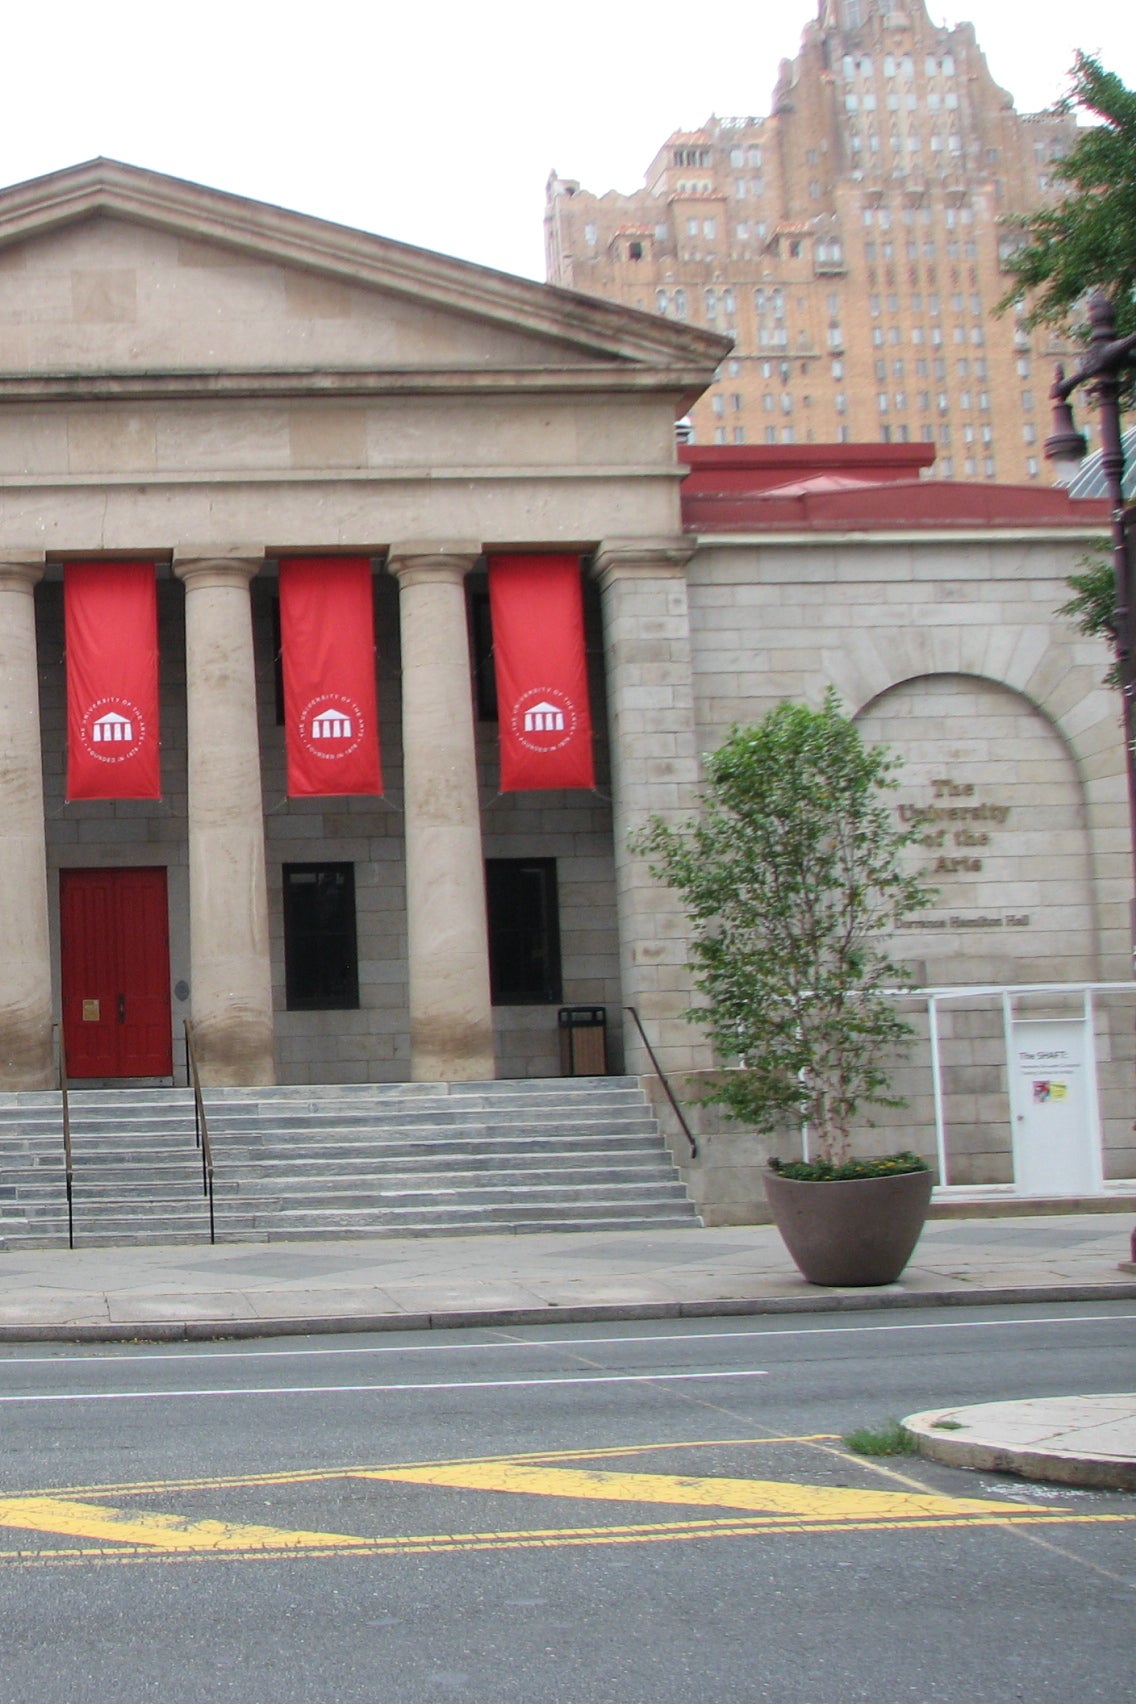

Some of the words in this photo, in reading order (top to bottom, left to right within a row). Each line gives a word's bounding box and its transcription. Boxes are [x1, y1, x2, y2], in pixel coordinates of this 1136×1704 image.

[82, 696, 120, 723] UNIVERSITY
[132, 707, 143, 720] THE
[87, 748, 116, 763] FOUNDED
[930, 779, 975, 798] The
[897, 803, 1010, 824] University
[921, 829, 944, 847] of
[953, 829, 989, 847] the
[933, 855, 982, 873] Arts
[949, 915, 1003, 928] Hamilton
[1005, 914, 1029, 926] Hall
[1017, 1051, 1035, 1060] The
